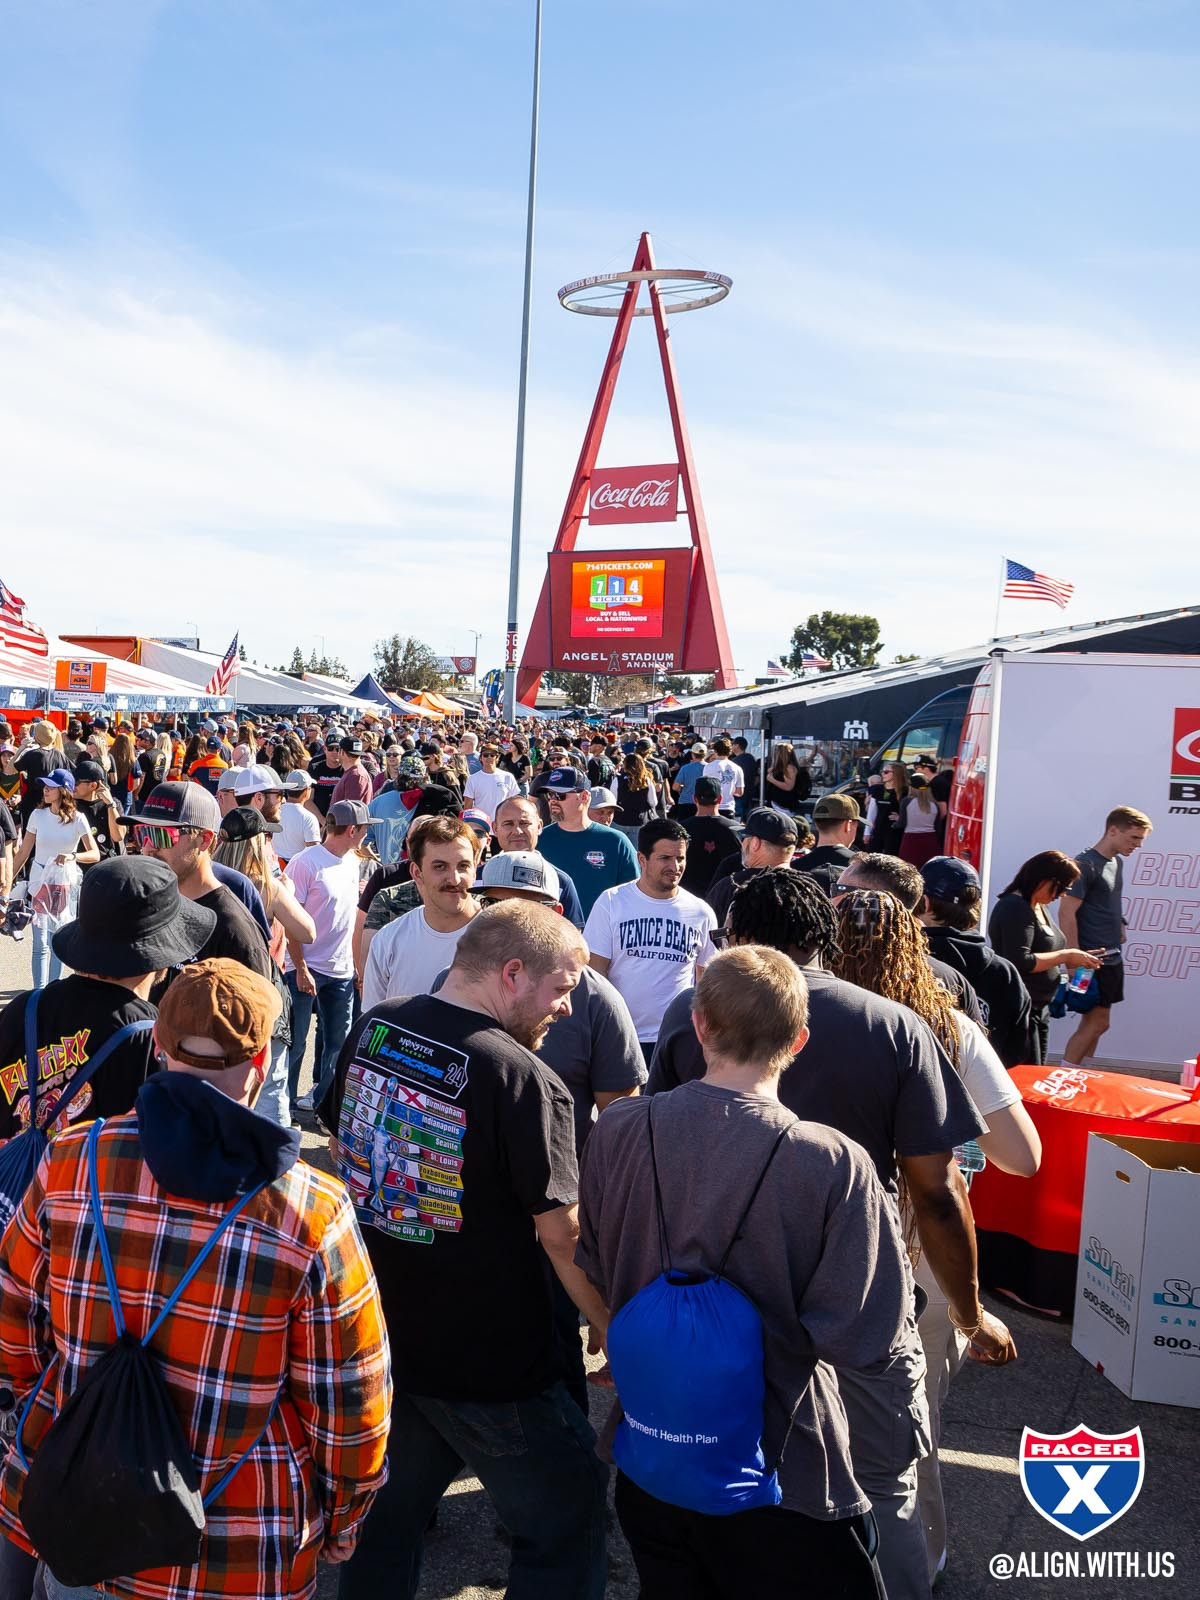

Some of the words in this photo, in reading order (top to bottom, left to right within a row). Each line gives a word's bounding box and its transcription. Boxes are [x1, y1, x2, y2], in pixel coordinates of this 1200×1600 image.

[591, 480, 675, 510] Coca-Cola
[586, 562, 653, 571] 714TICKETS.COM
[562, 652, 608, 661] ANGEL
[621, 652, 674, 661] STADIUM
[619, 917, 663, 950] VENICE
[627, 949, 688, 963] CALIFORNIA
[399, 1036, 434, 1057] MONSTER
[444, 1062, 465, 1088] 24
[425, 1096, 463, 1119] Birmingham
[421, 1114, 460, 1135] Indianapolis
[435, 1137, 458, 1151] Seattle
[440, 1155, 458, 1166] Louis
[427, 1183, 458, 1198] Nashville
[388, 1222, 402, 1233] Lake
[432, 1216, 456, 1227] Denver
[660, 1429, 693, 1444] Health
[695, 1434, 718, 1444] Plan
